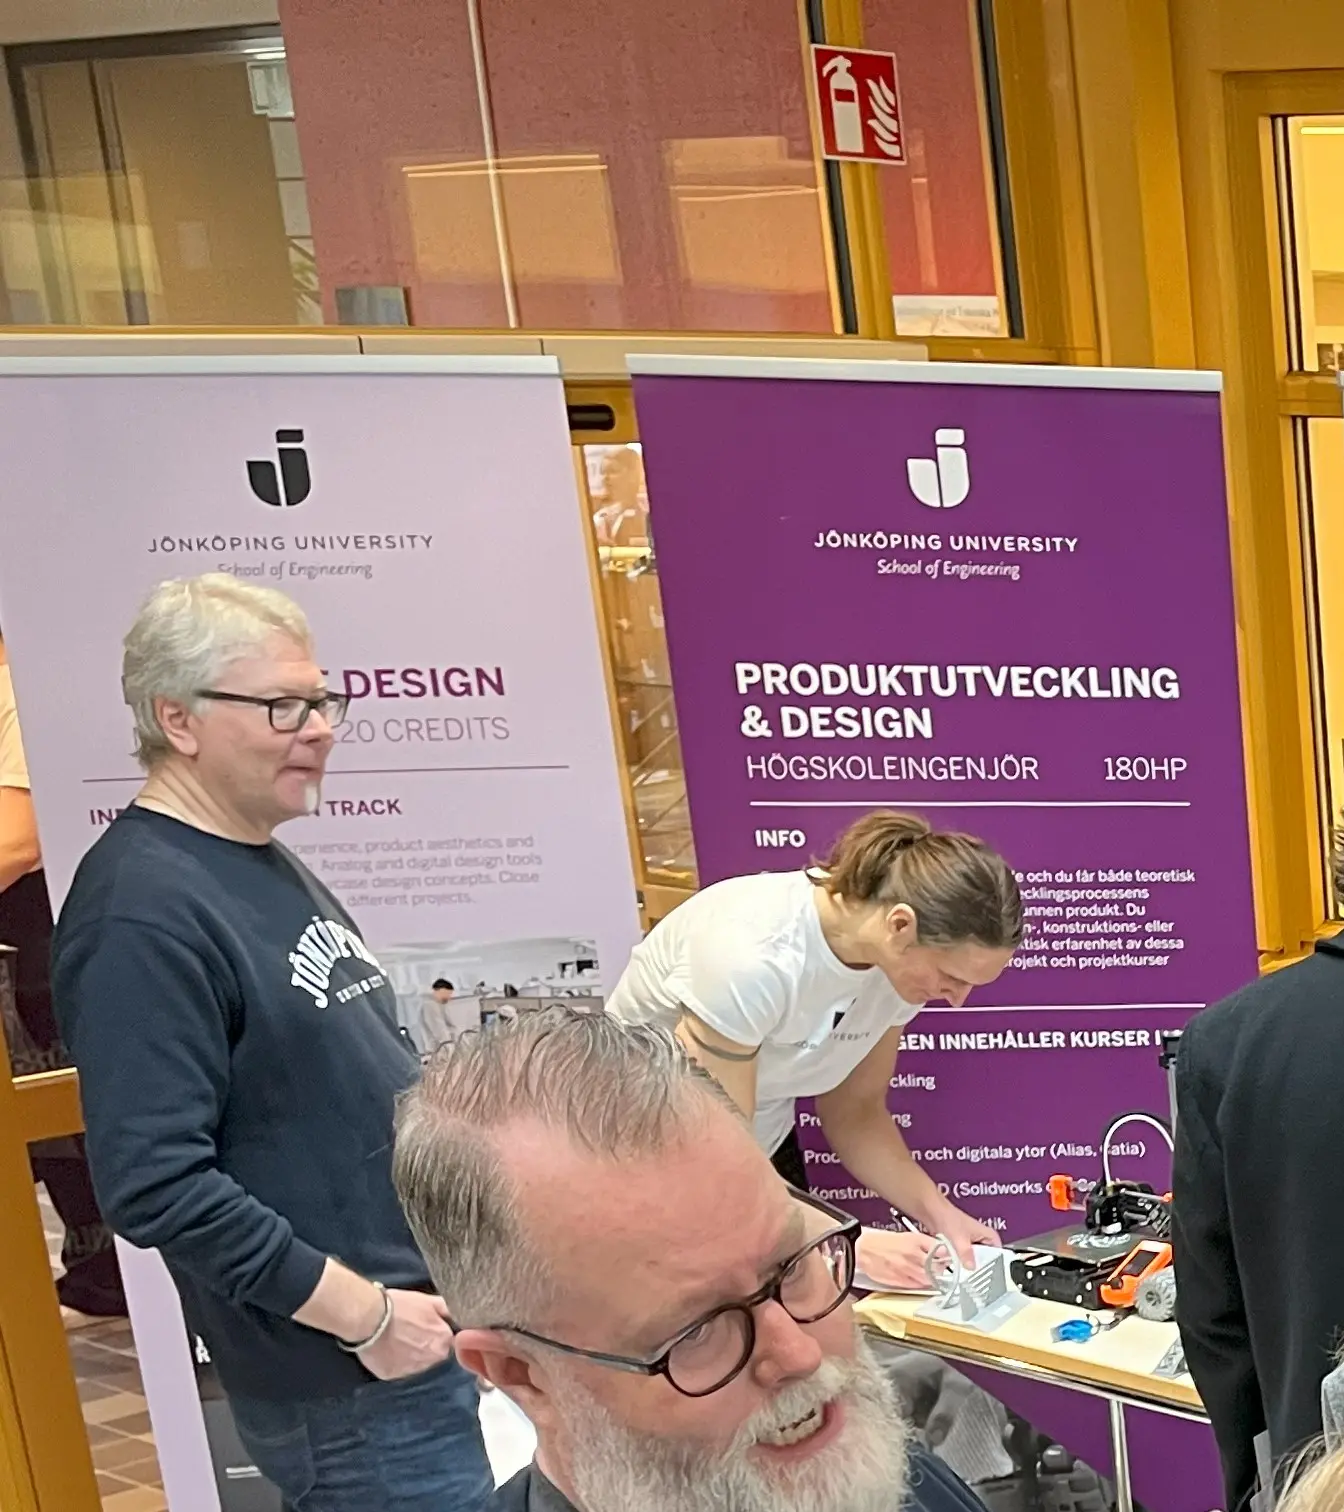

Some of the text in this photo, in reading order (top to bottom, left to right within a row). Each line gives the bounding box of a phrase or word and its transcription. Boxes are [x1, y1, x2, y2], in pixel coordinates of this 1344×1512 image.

[147, 534, 433, 553] JÖNKÖPING UNIVERSITY
[814, 530, 1078, 552] JÖNKÖPING UNIVERSITY
[217, 561, 373, 580] School of Engineering
[877, 559, 1020, 580] School of Engineering
[343, 666, 505, 699] DESIGN
[735, 662, 1180, 699] PRODUKTUTVECKLING
[333, 716, 510, 743] 20 CREDITS
[740, 705, 933, 739] & DESIGN
[746, 752, 1187, 781] HÖGSKOLEINGENJÖR 180HP
[325, 798, 402, 816] TRACK
[755, 829, 805, 848] INFO
[294, 842, 362, 855] perience,
[1026, 870, 1052, 882] och
[1054, 870, 1073, 883] du
[1075, 869, 1095, 882] får
[1098, 869, 1132, 882] både
[1135, 869, 1196, 882] teoretisk
[1020, 887, 1150, 902] ecklingsprocessens
[1023, 903, 1146, 919] nnen produkt. Du
[1043, 921, 1142, 934] konstruktions-
[1145, 921, 1174, 933] eller
[1019, 937, 1184, 950] tisk erfarenhet av dessa
[1008, 954, 1170, 970] rojekt och projektkurser
[939, 1029, 1066, 1050] INNEHÅLLER
[1070, 1030, 1150, 1048] KURSER
[925, 1147, 952, 1160] och
[956, 1144, 1012, 1162] digitala
[1015, 1146, 1046, 1162] ytor
[953, 1181, 1042, 1198] (Solidworks
